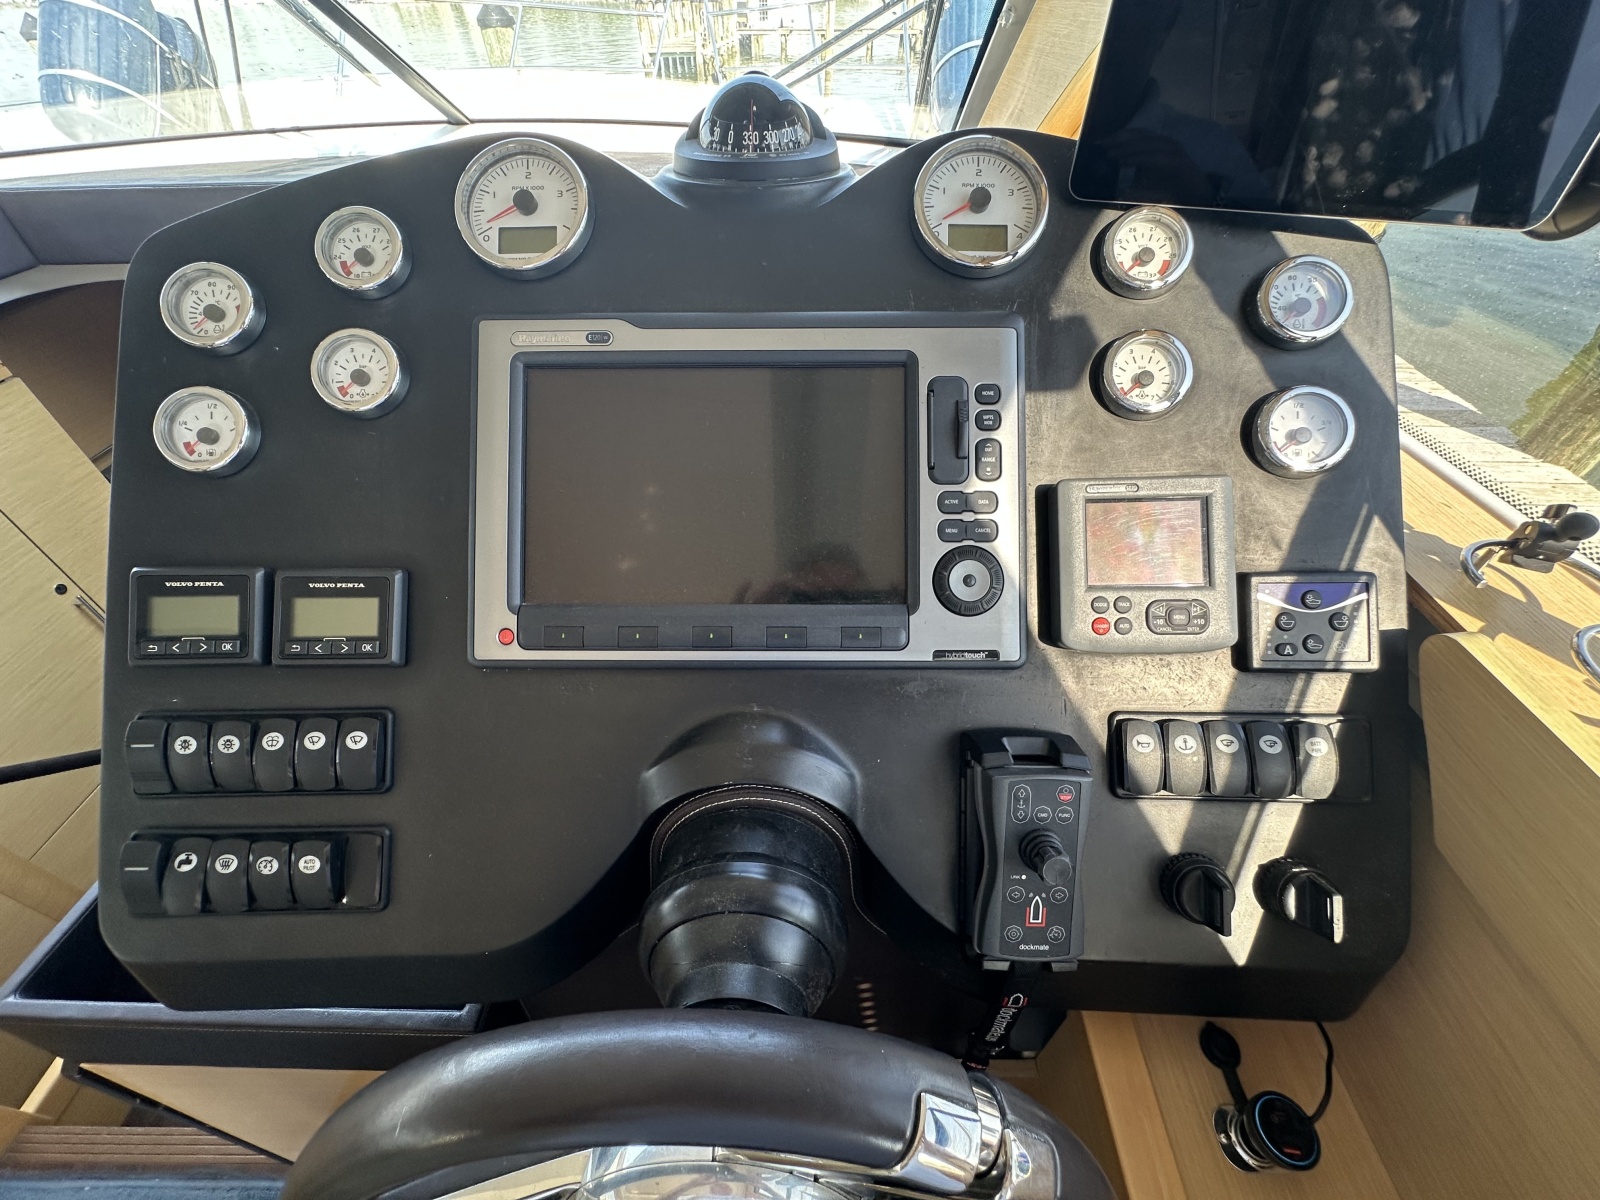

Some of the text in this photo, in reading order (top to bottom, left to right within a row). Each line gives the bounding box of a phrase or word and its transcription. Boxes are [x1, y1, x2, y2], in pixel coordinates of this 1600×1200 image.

[728, 131, 733, 143] 0
[743, 131, 759, 144] 330
[763, 131, 779, 144] 300
[782, 127, 795, 142] 270
[519, 335, 570, 344] Raymarine
[1284, 645, 1292, 654] A
